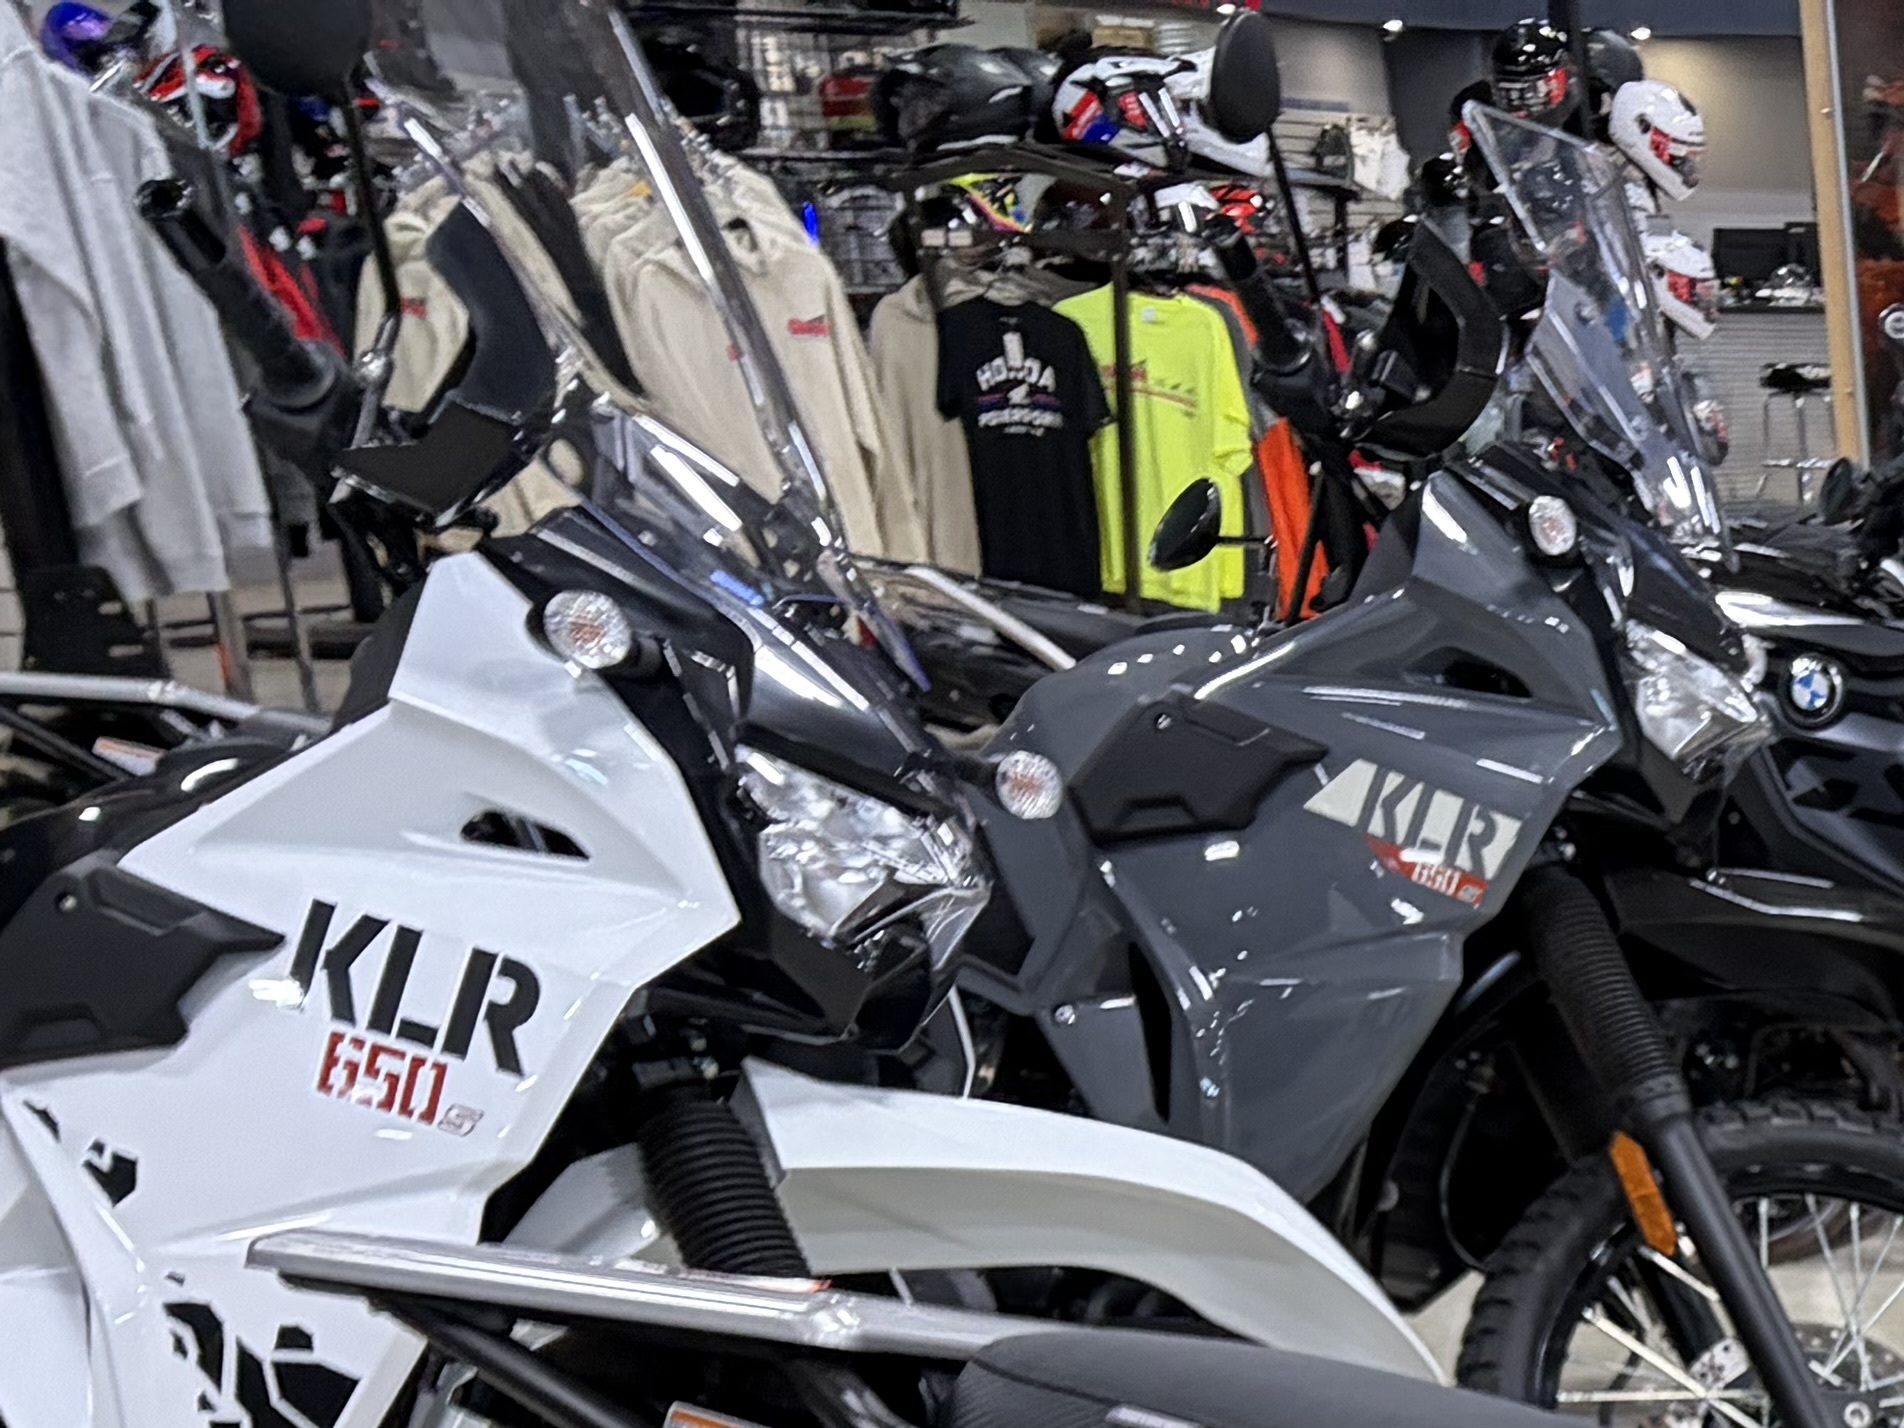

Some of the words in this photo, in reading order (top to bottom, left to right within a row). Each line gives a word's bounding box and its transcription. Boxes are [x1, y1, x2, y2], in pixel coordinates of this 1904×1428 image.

[976, 356, 1057, 392] HODA
[1355, 760, 1498, 881] KLR
[288, 897, 541, 1077] KLR
[316, 1031, 448, 1126] 650
